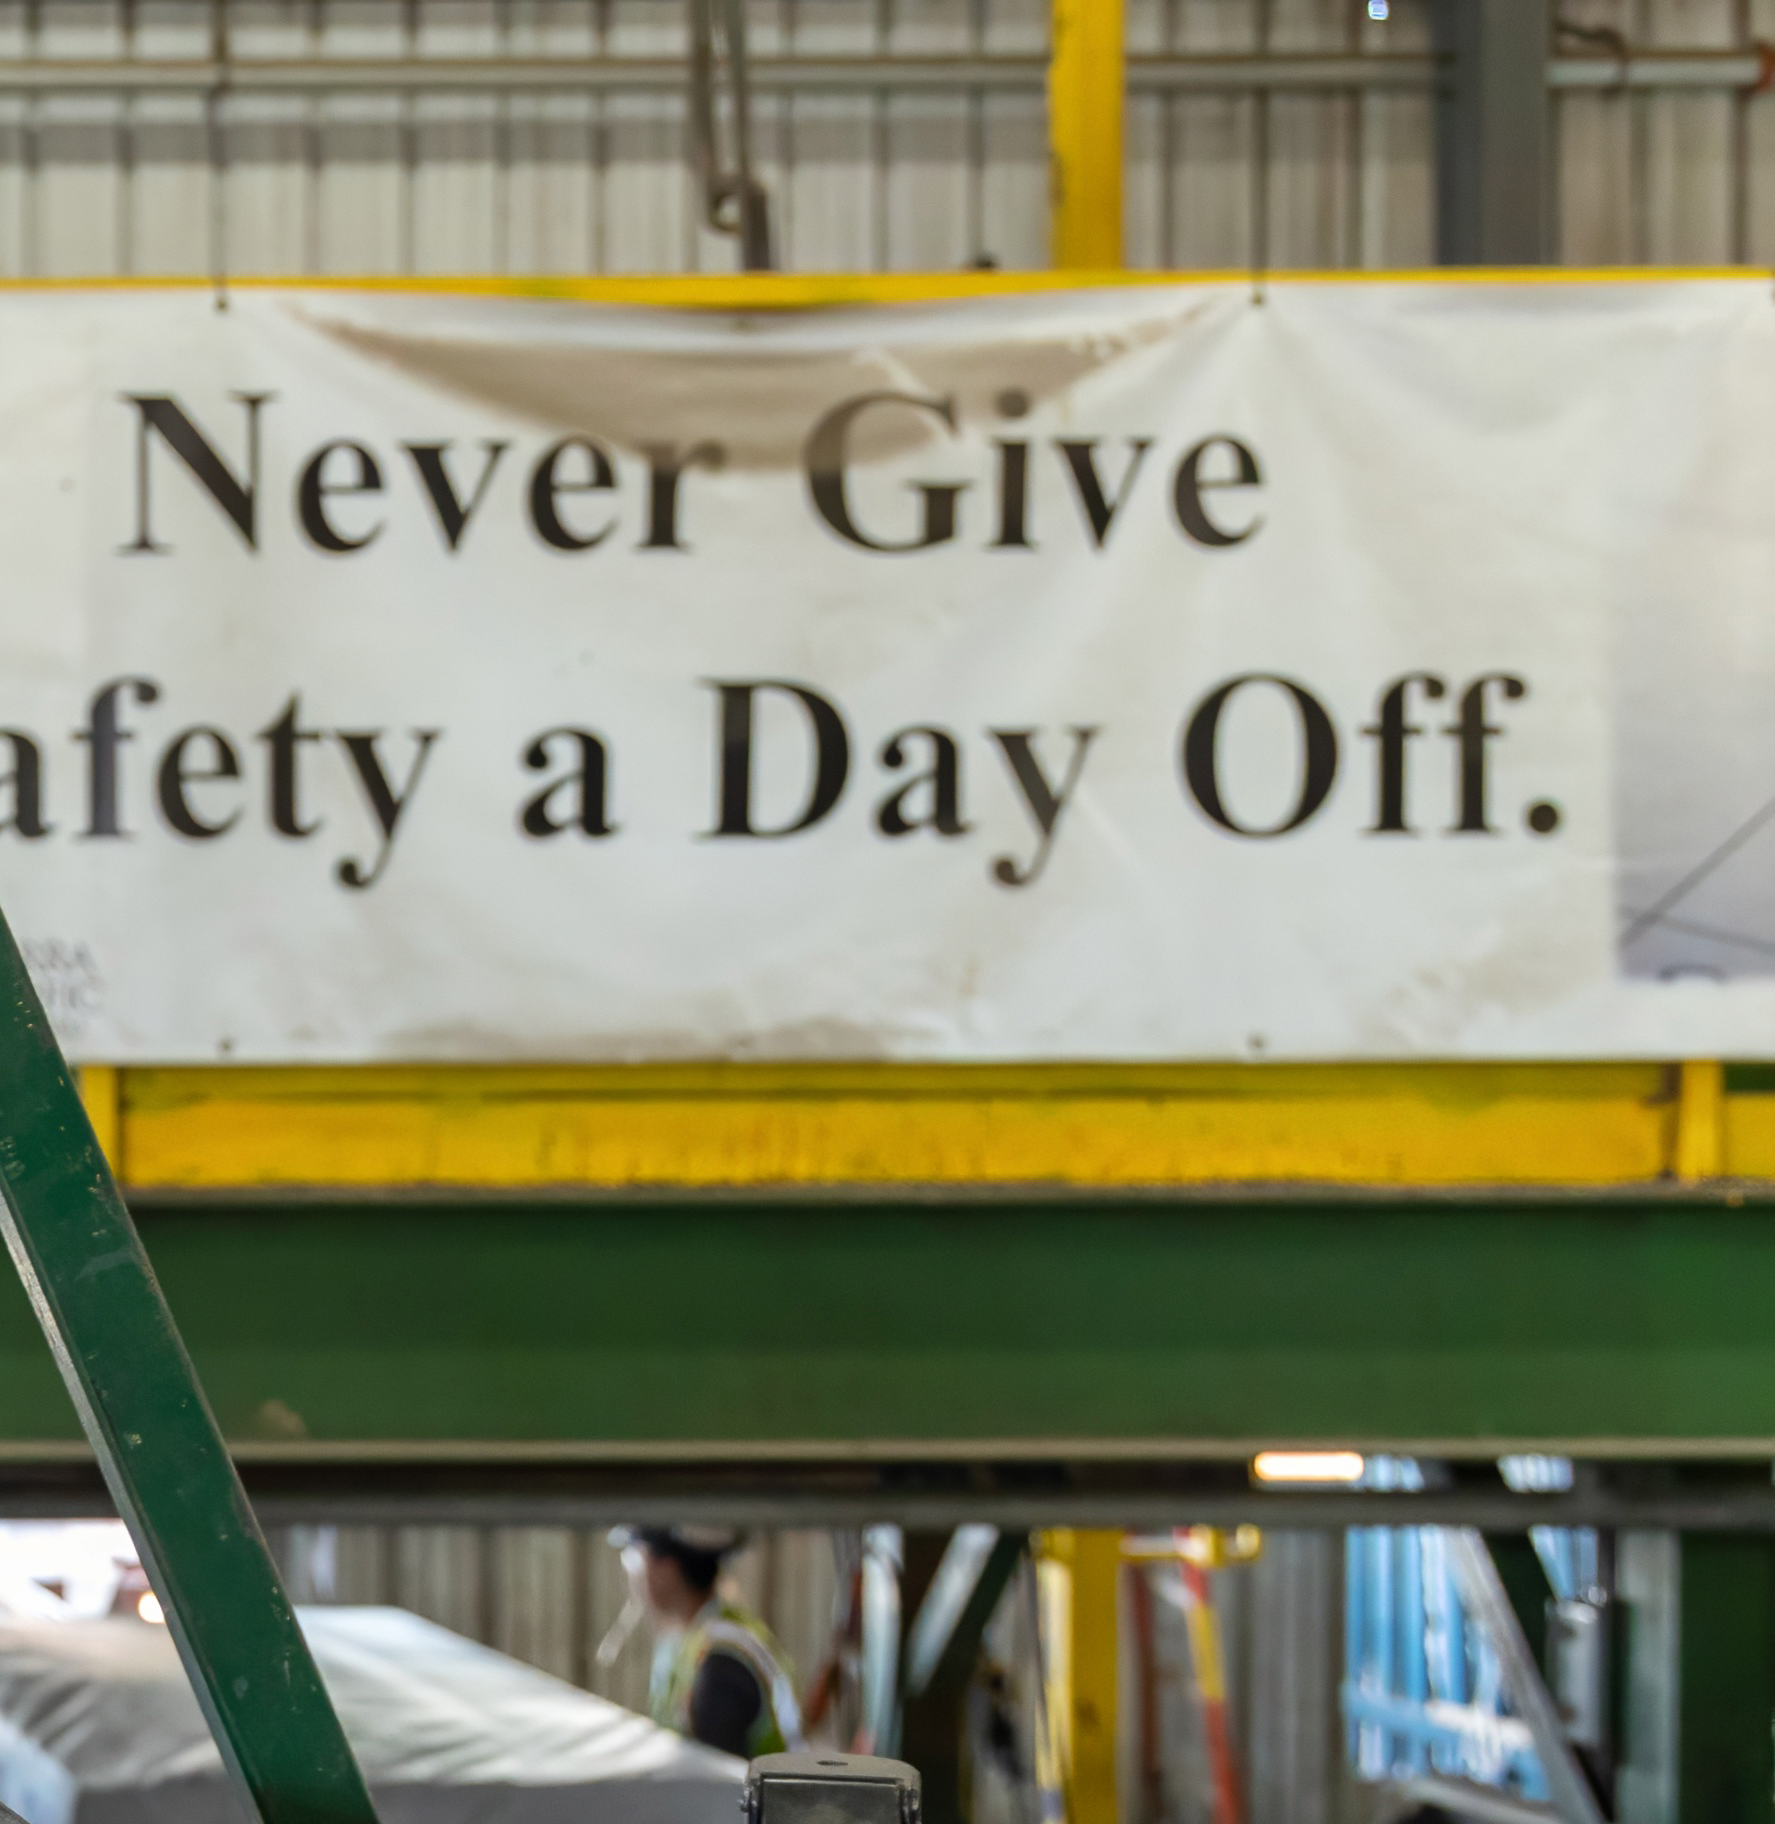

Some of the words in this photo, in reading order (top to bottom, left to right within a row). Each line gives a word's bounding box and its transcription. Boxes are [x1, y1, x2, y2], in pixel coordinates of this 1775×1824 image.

[122, 393, 734, 555] Never
[800, 389, 1268, 555] Give
[520, 728, 618, 841] a
[697, 681, 1098, 890] Day
[1180, 674, 1564, 837] Off.
